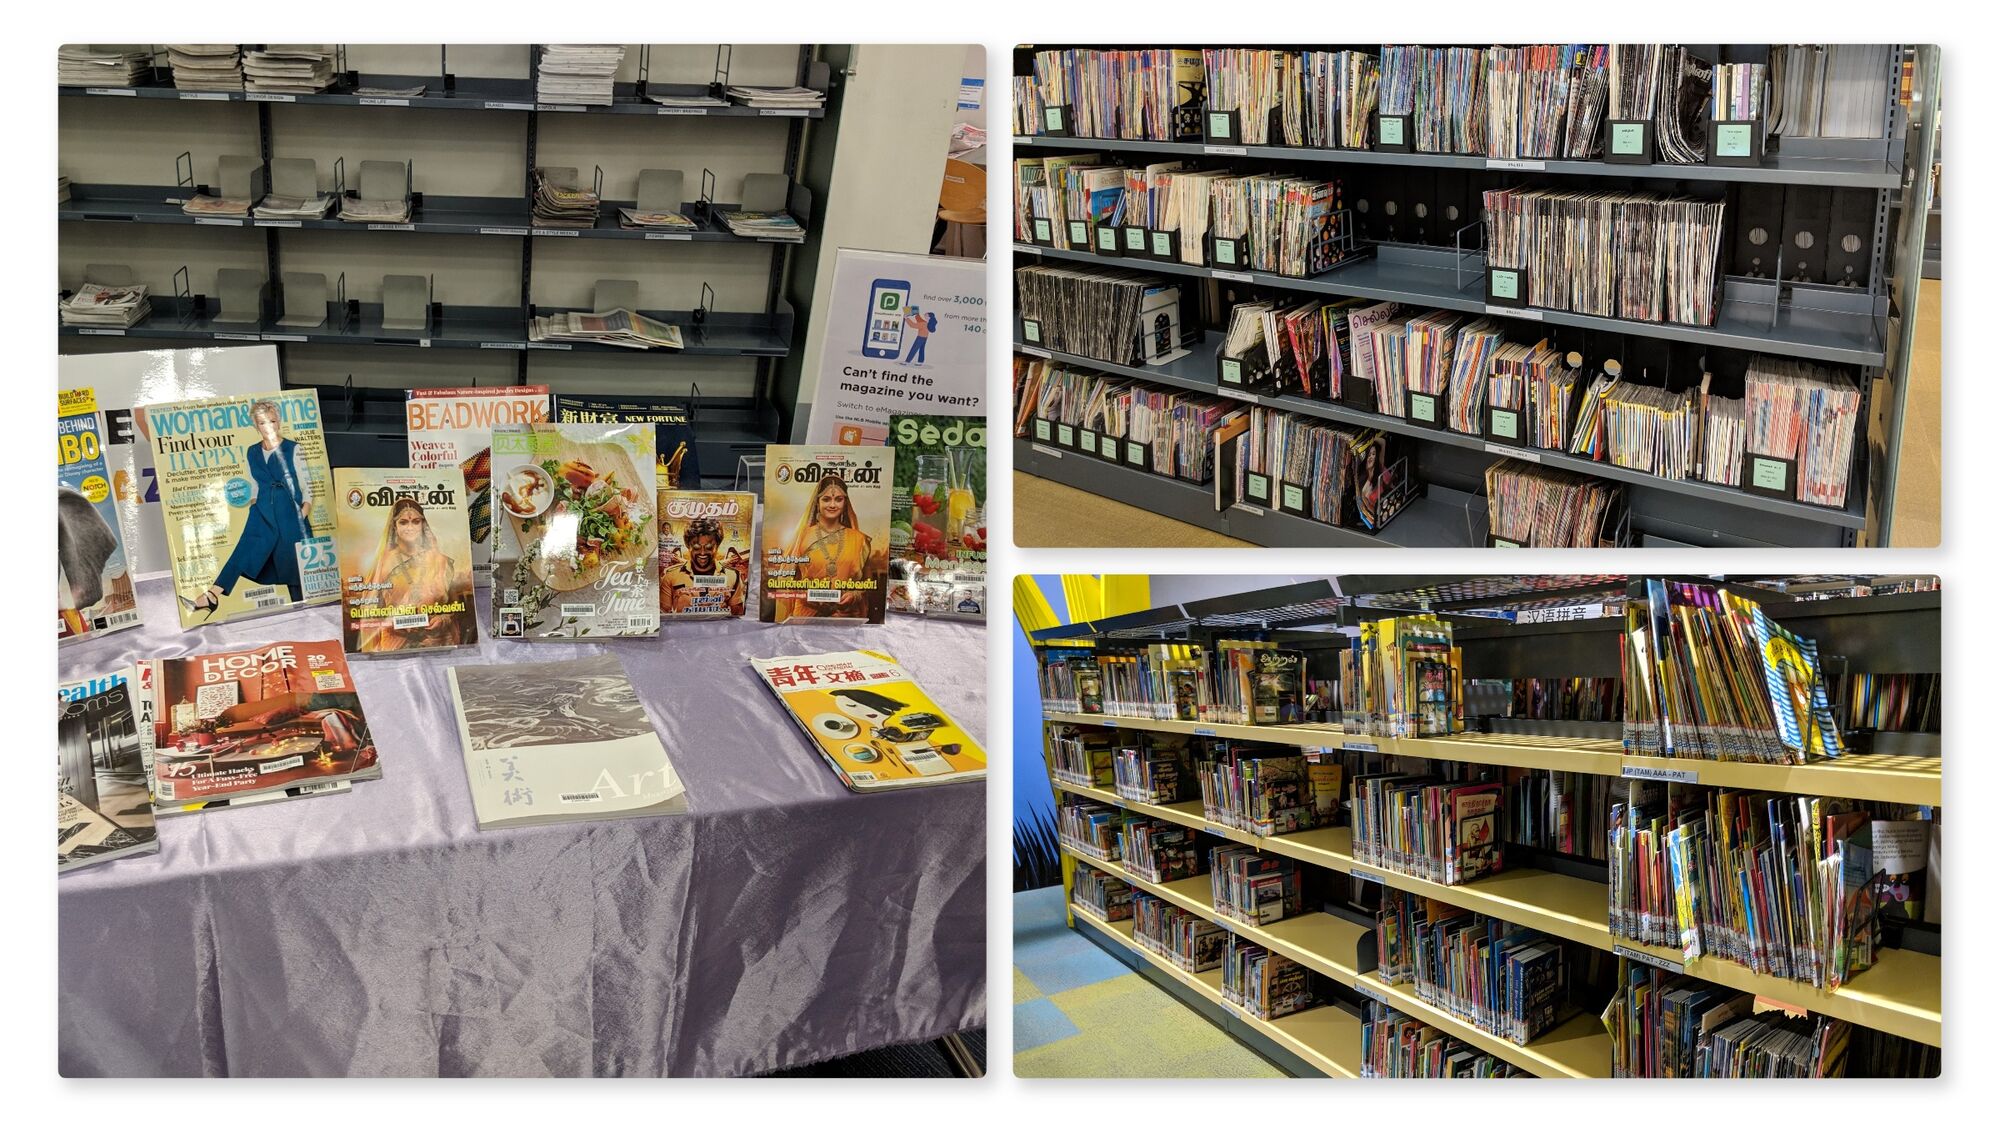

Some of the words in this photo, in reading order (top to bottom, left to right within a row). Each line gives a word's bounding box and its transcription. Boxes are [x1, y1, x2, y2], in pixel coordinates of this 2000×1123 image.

[954, 296, 984, 306] 3,000
[944, 313, 960, 321] from
[964, 324, 981, 334] 140
[843, 366, 878, 379] Can't
[881, 370, 908, 383] find
[911, 375, 933, 386] the
[840, 382, 904, 398] magazine
[908, 392, 933, 402] you
[938, 394, 979, 408] want?
[836, 401, 863, 411] Switch
[408, 400, 548, 430] BEADWORK
[58, 417, 94, 434] BEHIND
[157, 433, 196, 454] Find
[198, 434, 235, 455] your
[411, 440, 446, 450] Weave
[169, 446, 245, 472] HAPPY!
[412, 450, 457, 462] Colorful
[166, 469, 197, 478] Declutter,
[210, 464, 240, 473] organised
[794, 461, 882, 484] விகடன்
[367, 484, 455, 507] விகடன்
[667, 499, 739, 519] குமுதம்
[300, 543, 336, 570] 25
[304, 571, 340, 584] BRITISH
[594, 560, 633, 590] Tea
[304, 579, 341, 592] BREAKS
[768, 577, 830, 589] பொன்னியின்
[835, 578, 877, 590] செல்வன்!
[350, 604, 416, 618] பொன்னியின்
[420, 601, 465, 615] செல்வன்!
[597, 588, 646, 616] Time
[1528, 607, 1587, 623] 汉语拼音
[203, 645, 295, 673] HOME
[204, 658, 298, 683] DECOR
[192, 770, 227, 780] Ultimate
[229, 766, 255, 775] Hacks
[216, 773, 258, 782] Fuss-Free
[590, 762, 677, 798] Art
[1635, 768, 1652, 777] (TAM)
[192, 782, 232, 792] Year-End
[233, 779, 256, 787] Party
[1625, 949, 1641, 960] (TAM)
[1642, 954, 1654, 963] PAT
